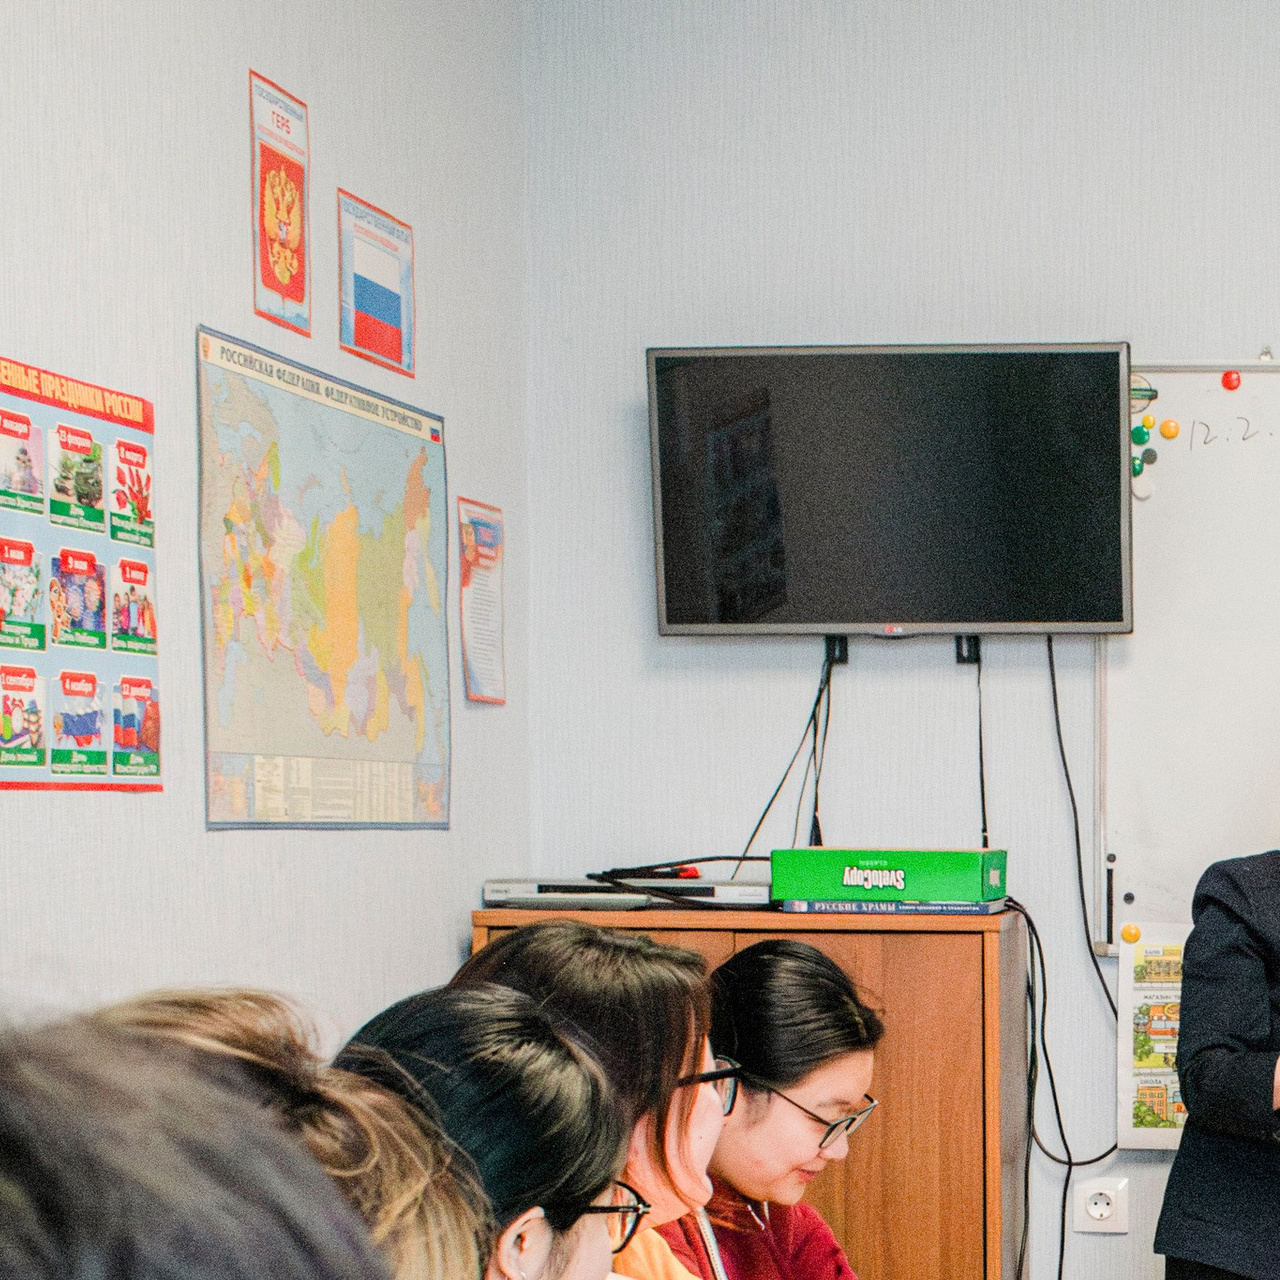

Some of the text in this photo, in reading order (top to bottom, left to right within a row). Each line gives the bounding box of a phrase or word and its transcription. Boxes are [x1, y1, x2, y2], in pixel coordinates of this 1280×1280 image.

[271, 110, 291, 135] ГЕРБ
[220, 346, 274, 380] РОССИЙСКАЯ
[40, 372, 104, 412] ПРАЗДНИКИ
[103, 391, 143, 422] РОССИИ
[843, 866, 905, 889] SvetoCopy
[861, 902, 896, 912] ХРАМЫ
